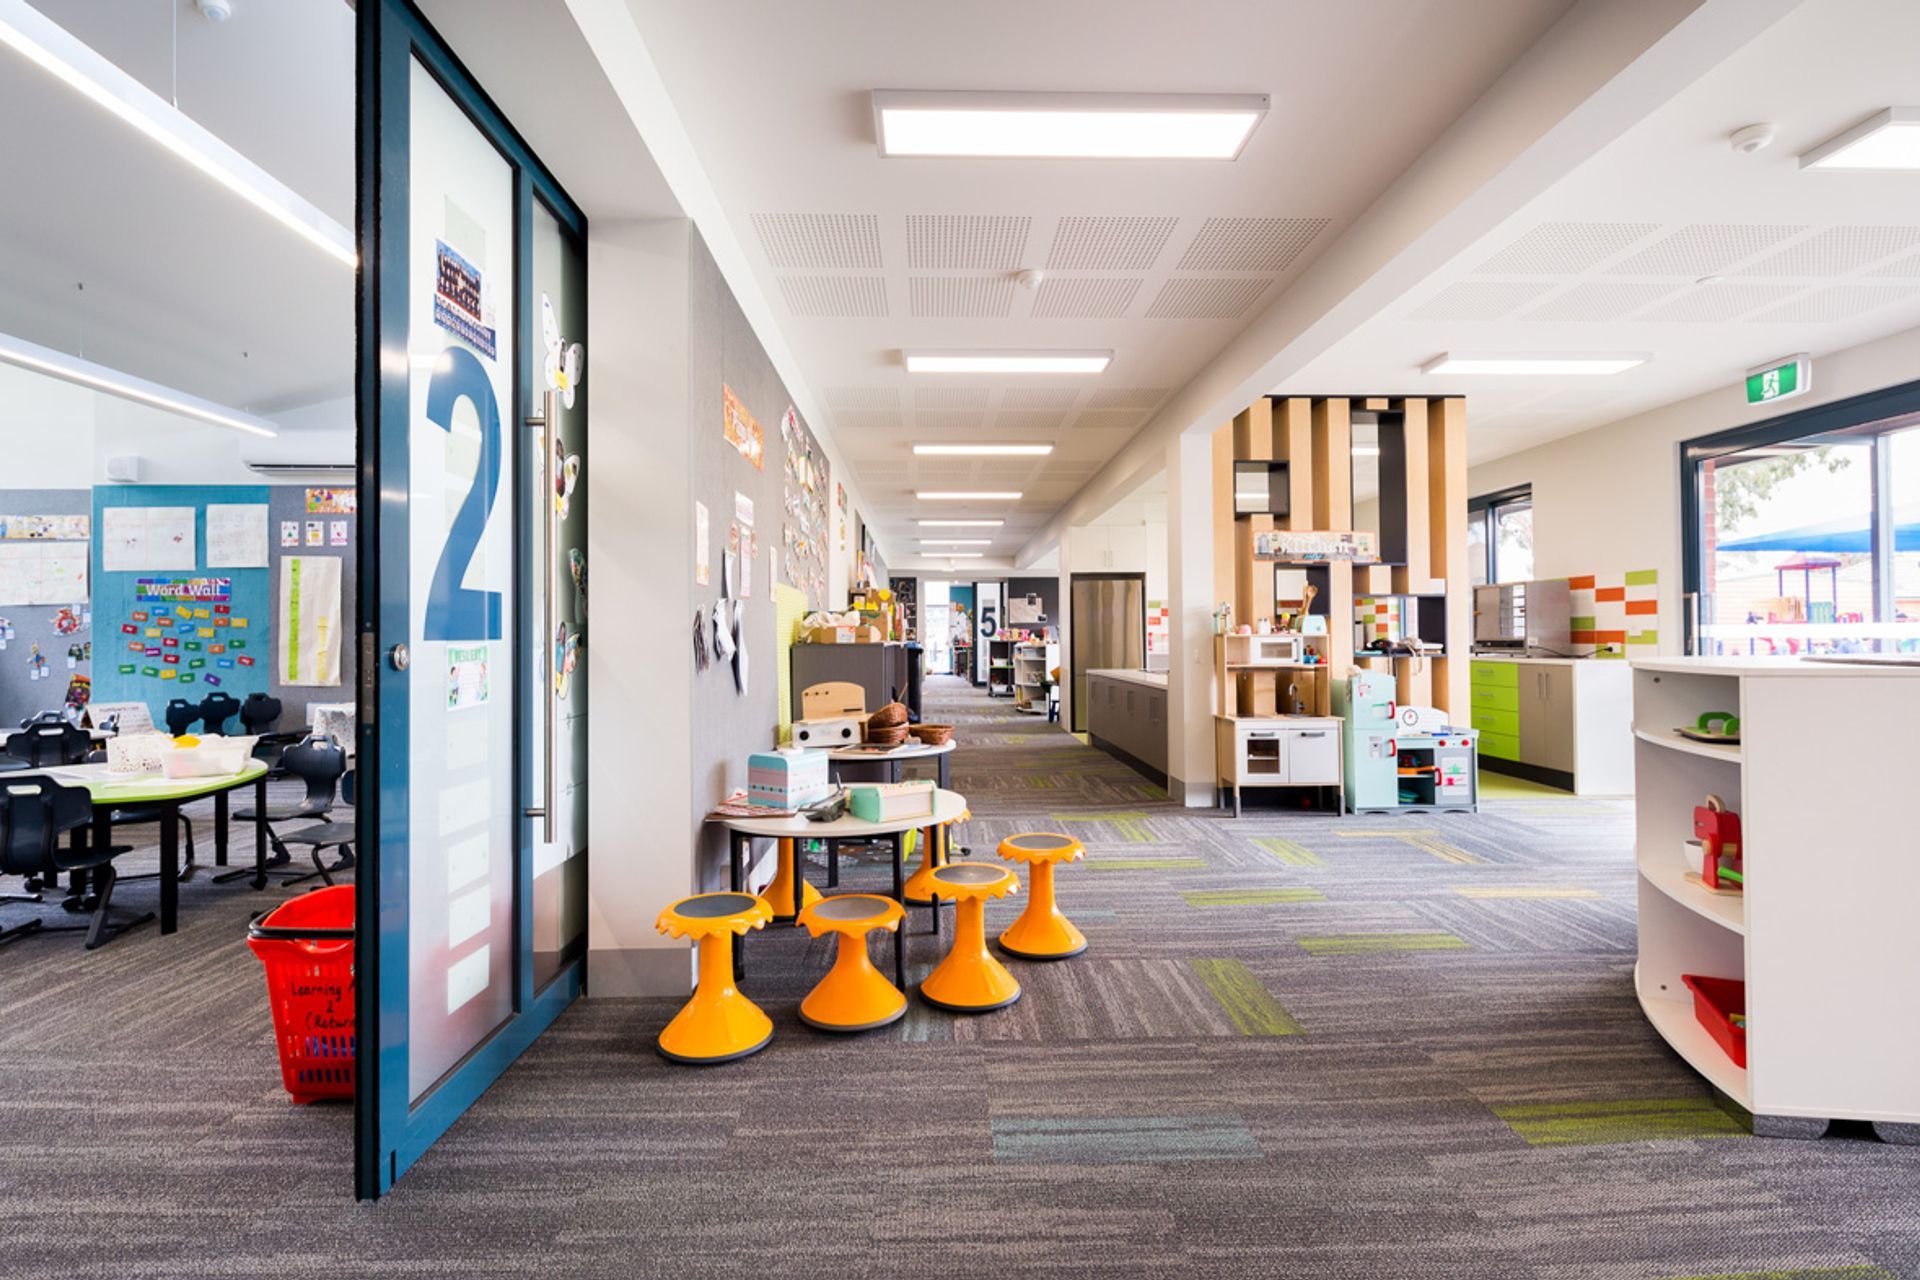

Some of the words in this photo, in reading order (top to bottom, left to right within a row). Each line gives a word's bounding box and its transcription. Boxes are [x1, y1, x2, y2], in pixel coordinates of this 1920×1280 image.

[424, 345, 502, 640] 2
[146, 583, 183, 596] Word
[188, 583, 220, 596] Wall
[980, 607, 997, 638] 5
[291, 981, 342, 1002] Learning
[326, 1000, 334, 1013] 2
